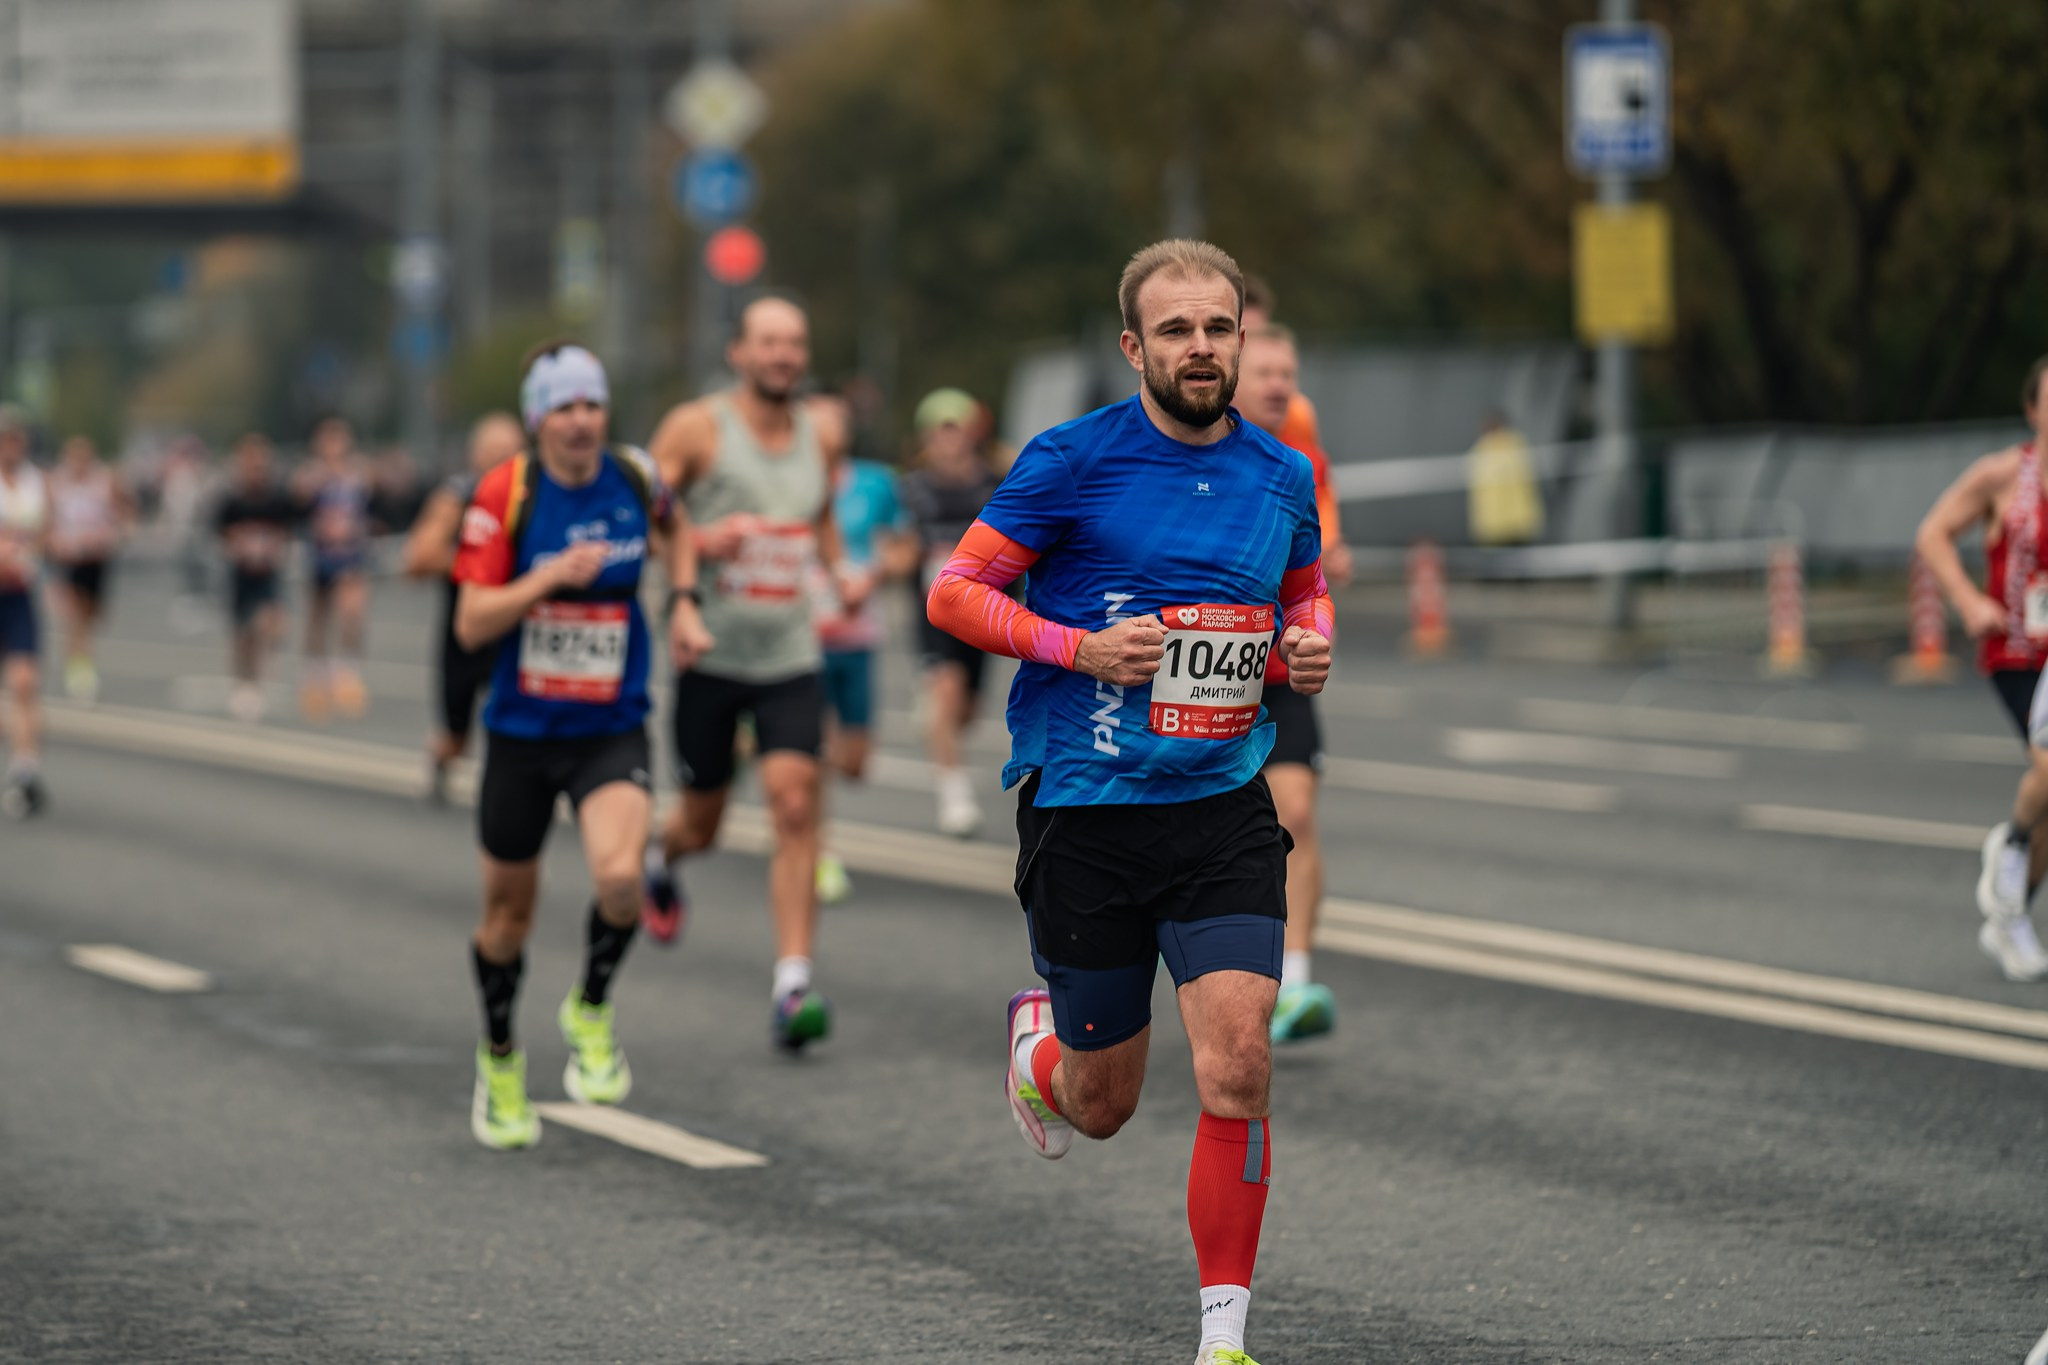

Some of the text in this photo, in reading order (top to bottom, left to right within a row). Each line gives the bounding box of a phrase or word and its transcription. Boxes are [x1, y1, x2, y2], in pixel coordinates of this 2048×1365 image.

[1201, 607, 1236, 615] СБЕРПРАЙМ
[1201, 613, 1247, 623] МОСКОВСКИЙ
[1201, 620, 1235, 629] МАРАФОН
[1166, 638, 1269, 681] 10488
[1190, 685, 1246, 700] ДМИТРИЙ
[1161, 707, 1180, 732] B
